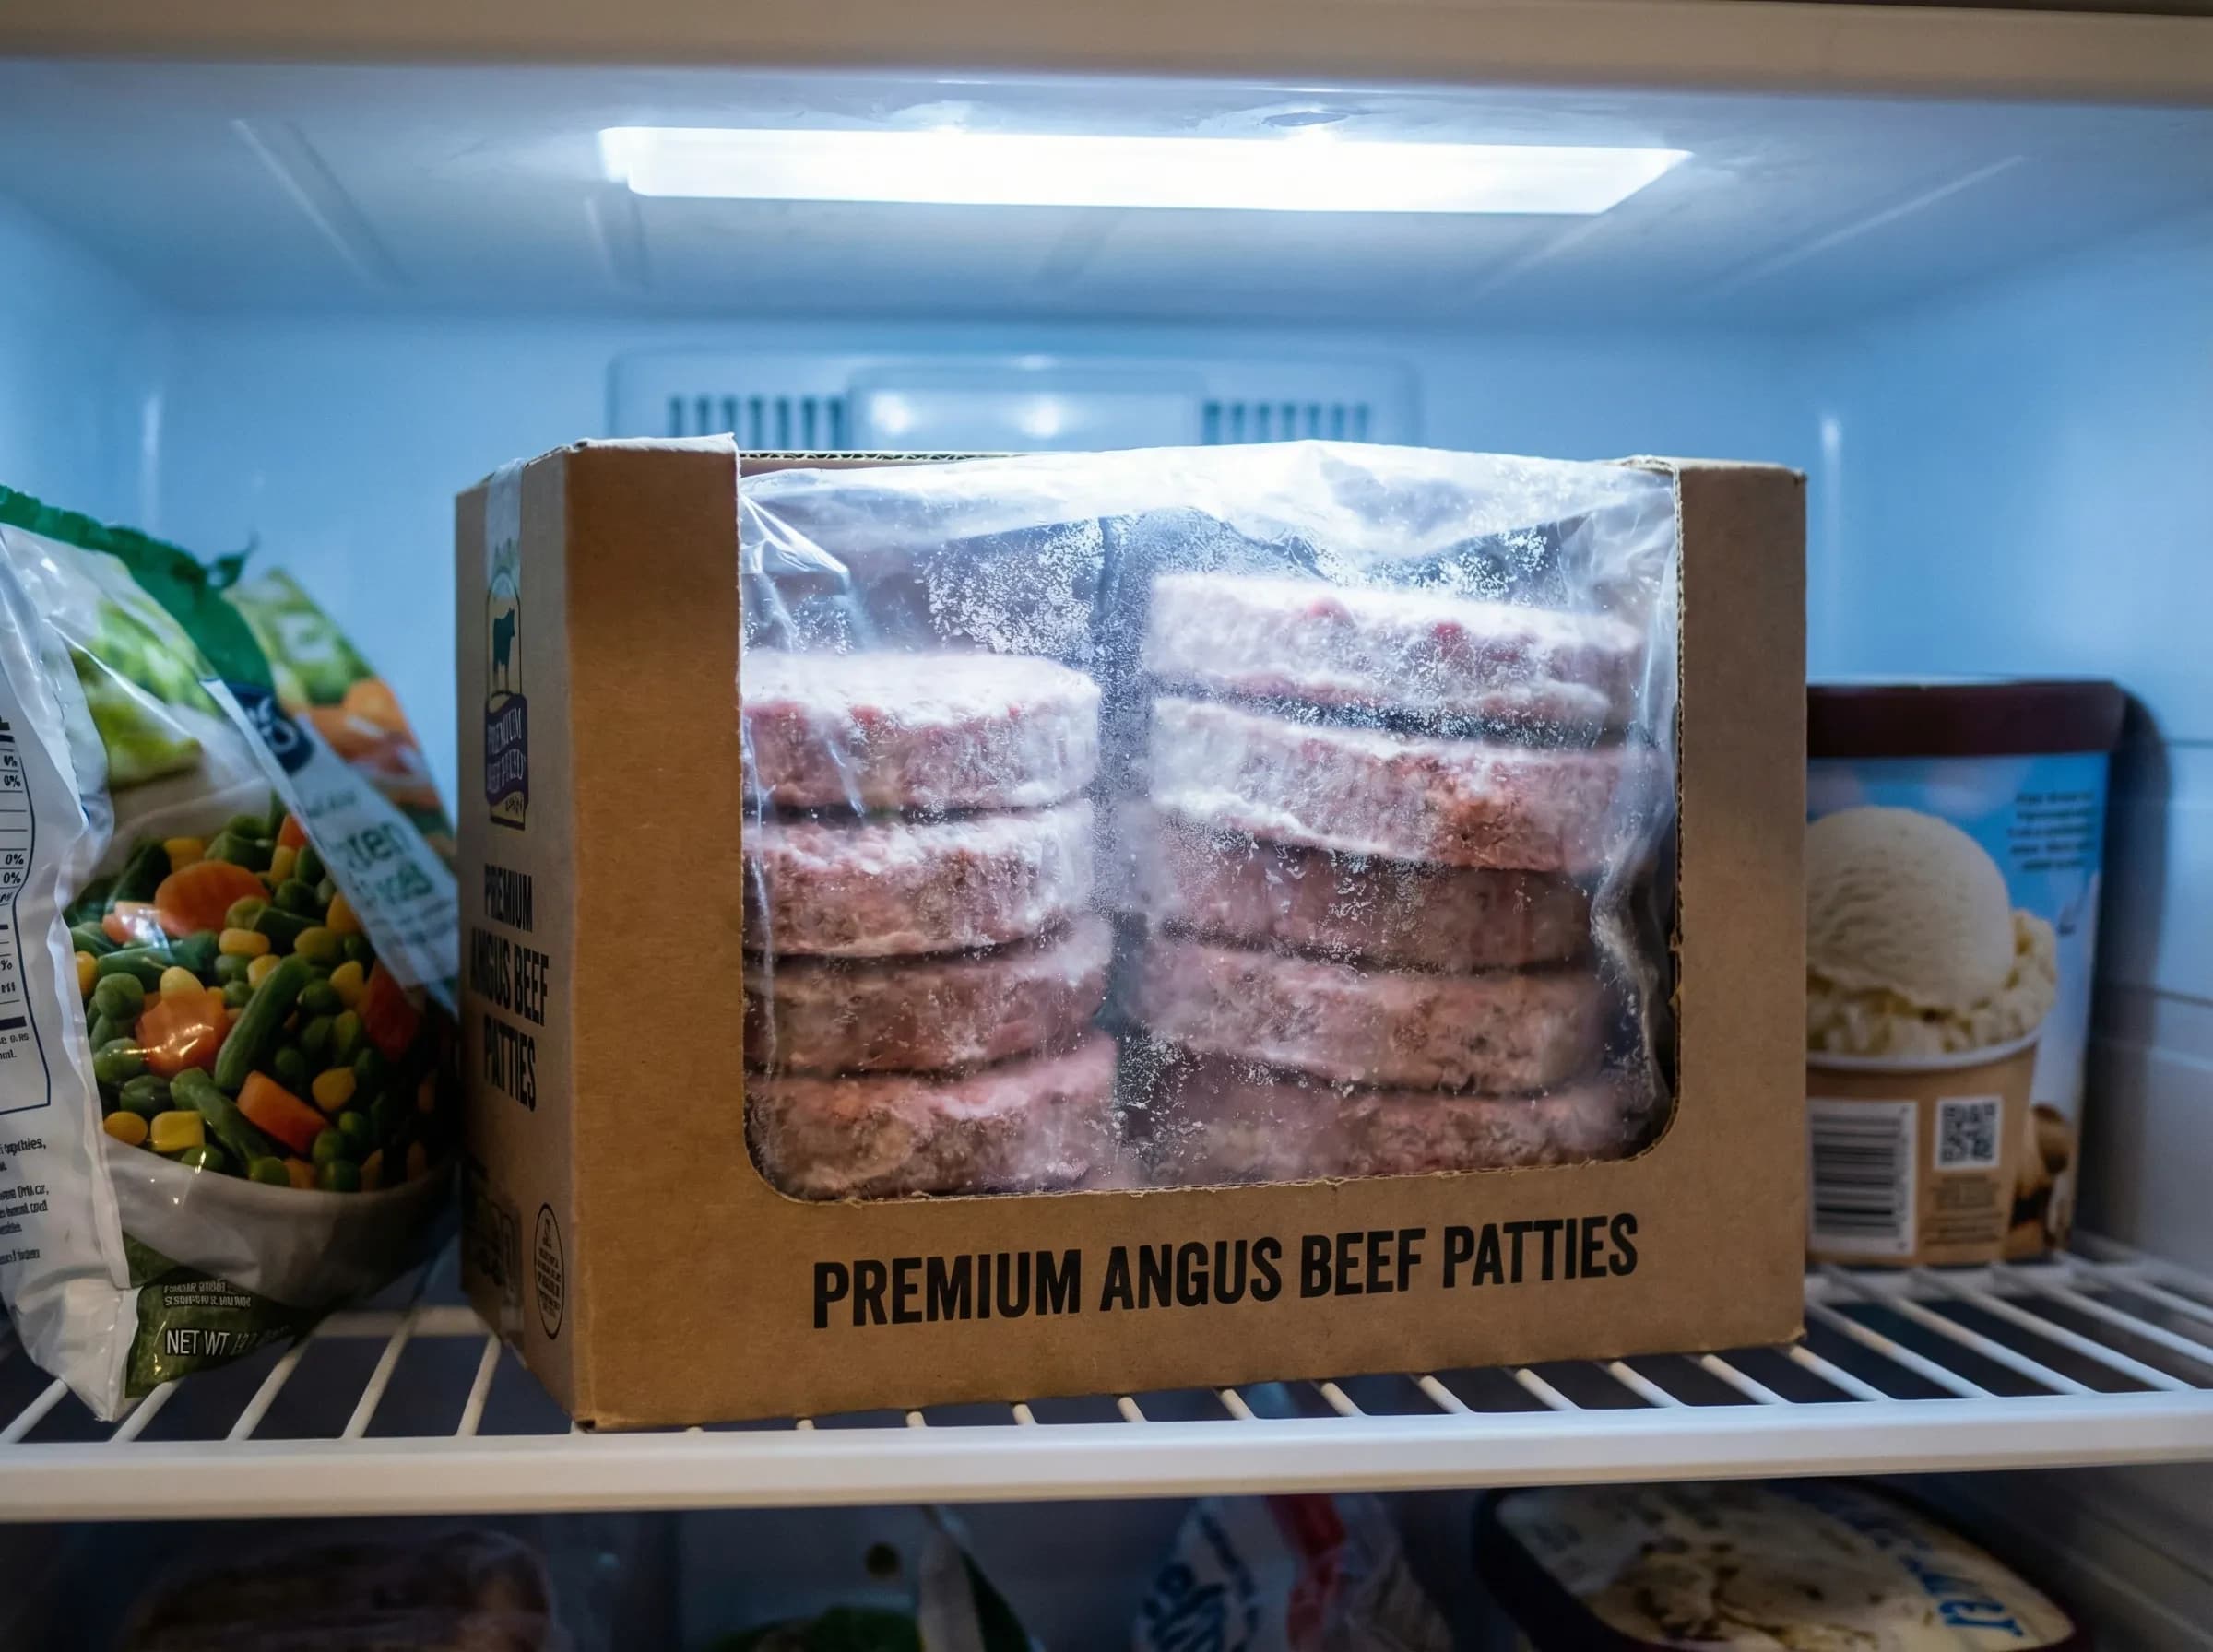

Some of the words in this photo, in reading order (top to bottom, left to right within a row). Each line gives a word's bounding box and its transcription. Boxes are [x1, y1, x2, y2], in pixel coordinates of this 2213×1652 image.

[3, 872, 21, 884] 0%
[6, 854, 24, 865] 0%
[513, 945, 550, 1027] BEEF
[483, 1013, 537, 1112] PATTIES
[814, 1249, 1081, 1328] PREMIUM
[1100, 1237, 1282, 1311] ANGUS
[1301, 1228, 1426, 1298] BEEF
[1443, 1213, 1638, 1288] PATTIES
[166, 1329, 200, 1355] NET
[204, 1330, 231, 1356] WT
